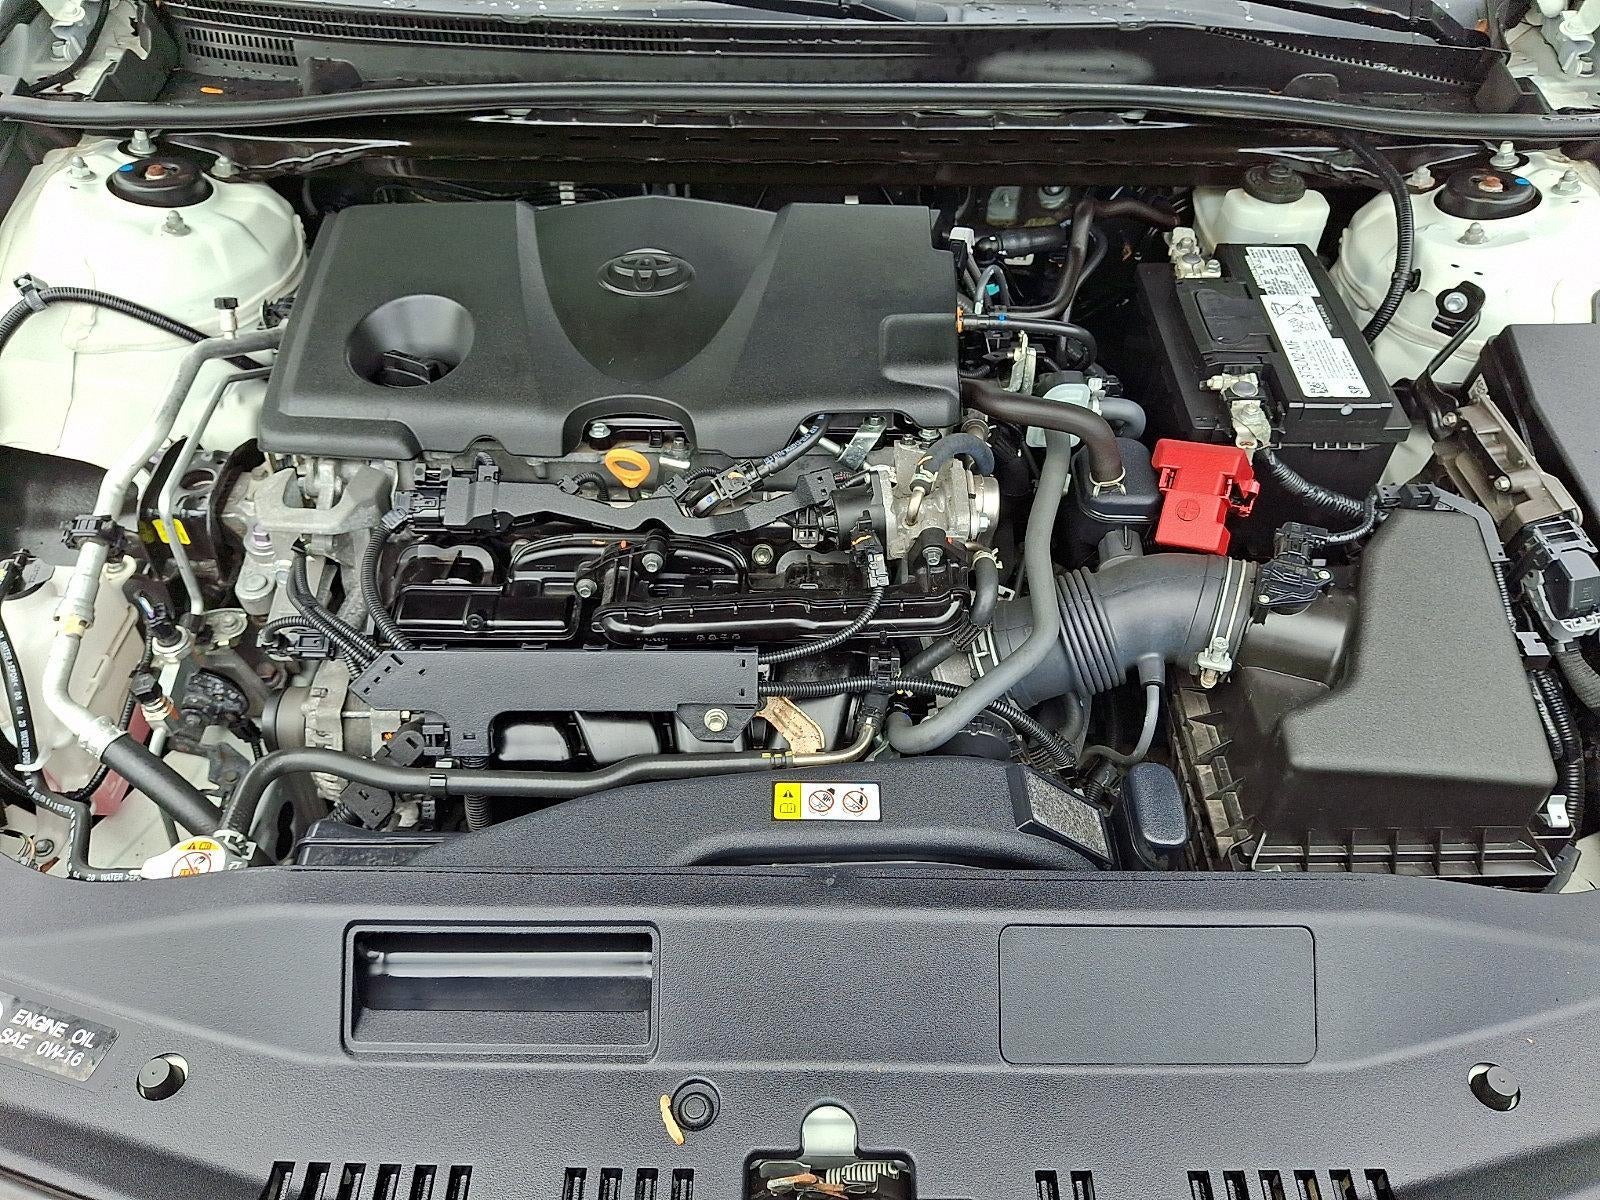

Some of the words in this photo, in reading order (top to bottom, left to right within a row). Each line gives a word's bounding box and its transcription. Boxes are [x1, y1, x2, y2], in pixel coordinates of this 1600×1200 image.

[100, 872, 124, 882] WATER
[0, 1028, 34, 1050] SAE
[36, 1040, 85, 1067] 0W-16
[11, 1008, 70, 1038] ENGINE
[71, 1029, 96, 1049] OIL
